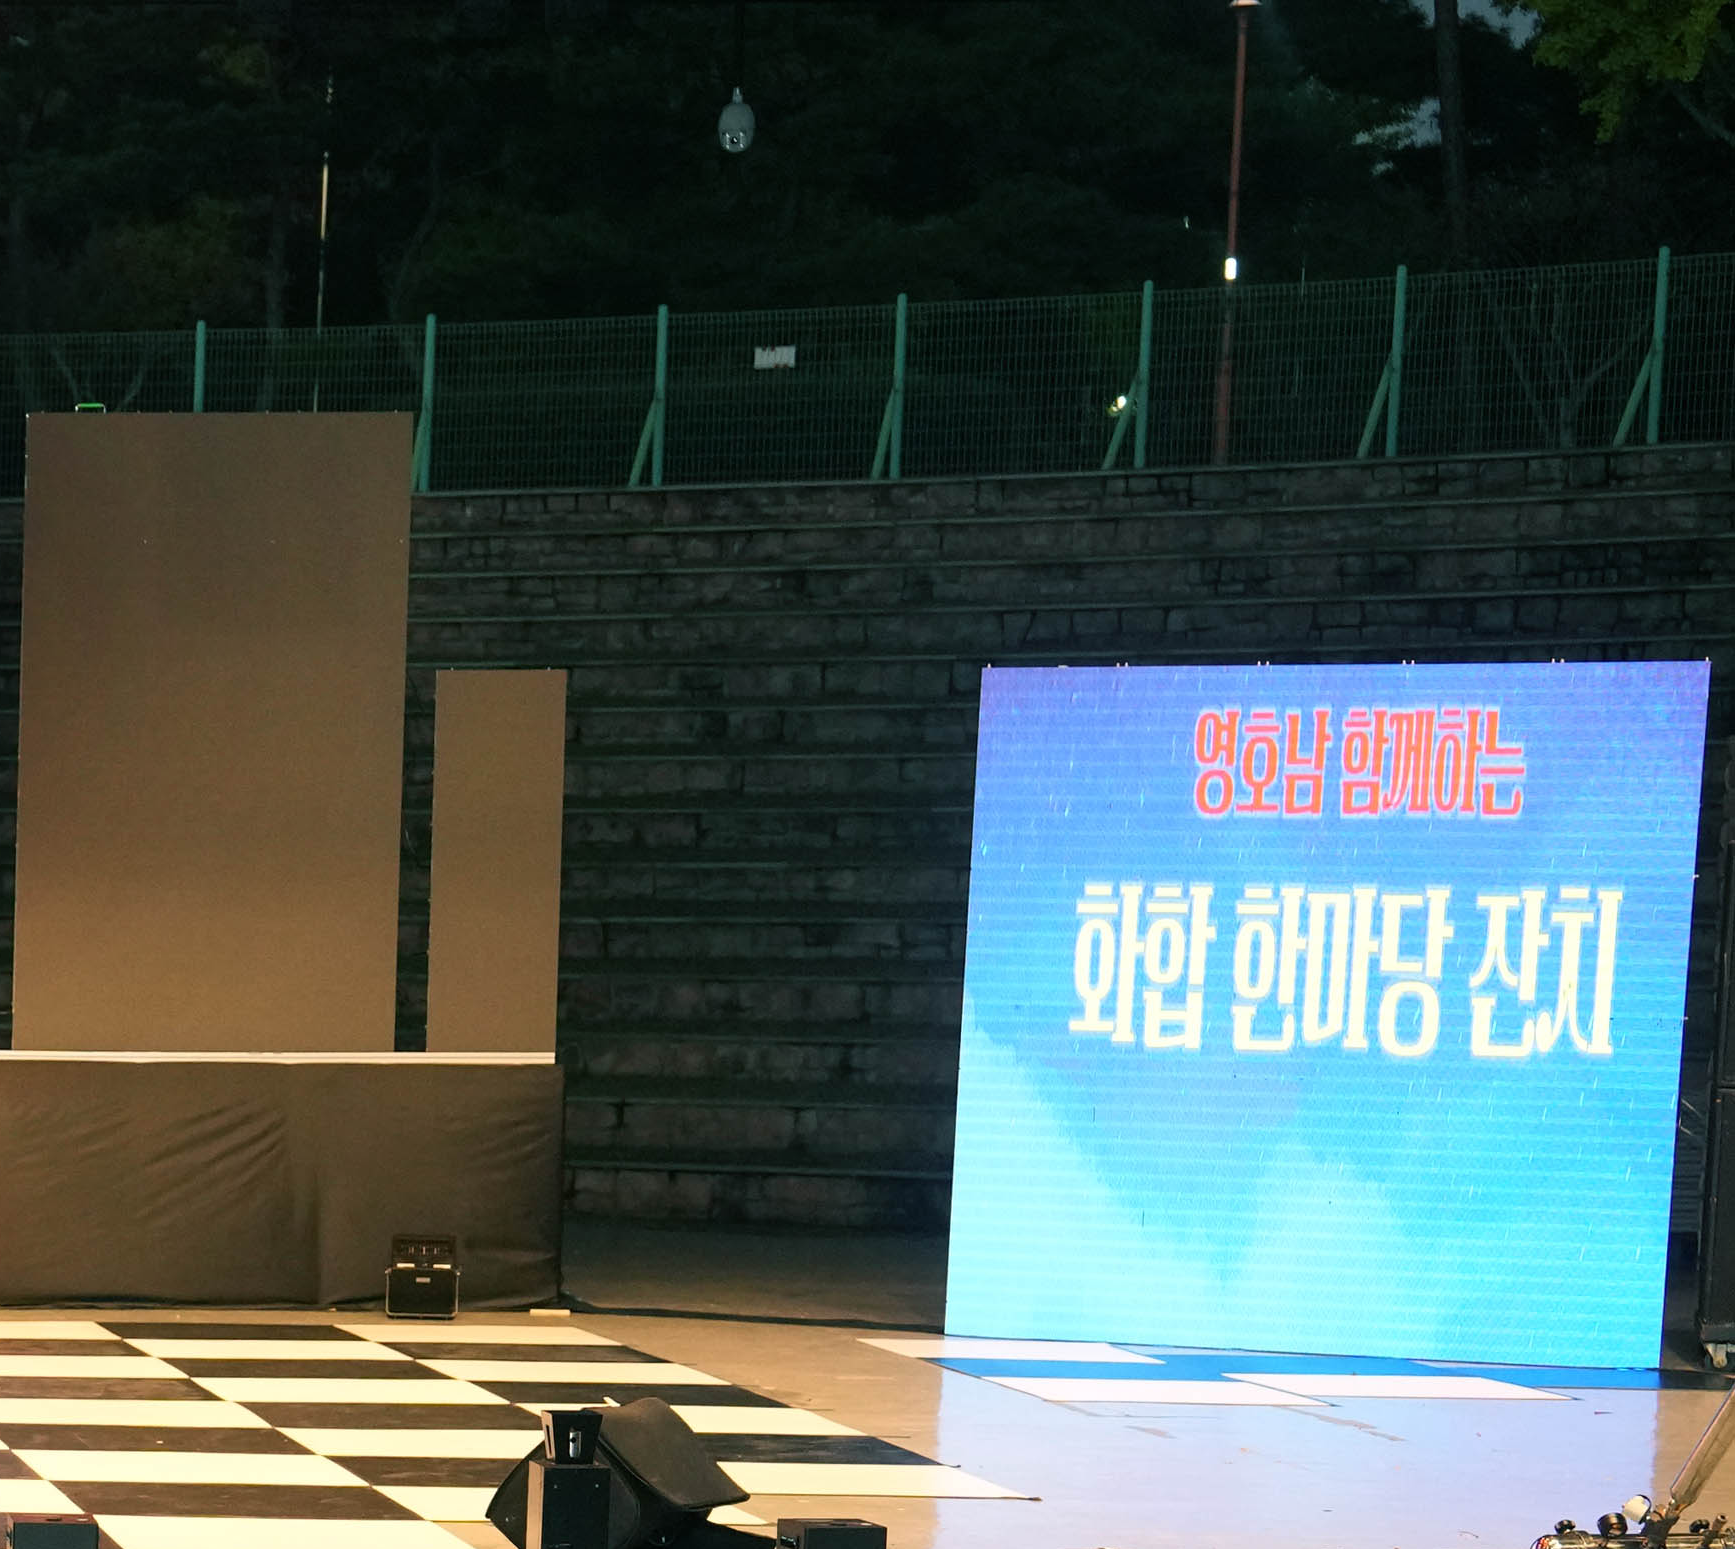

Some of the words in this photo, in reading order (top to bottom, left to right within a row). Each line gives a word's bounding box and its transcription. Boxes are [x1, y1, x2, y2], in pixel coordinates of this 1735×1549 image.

[1194, 708, 1330, 816] 영호남
[1340, 708, 1527, 817] 함께하는
[1068, 884, 1216, 1050] 화합
[1231, 886, 1454, 1056] 한마당
[1470, 886, 1625, 1058] 잔치
